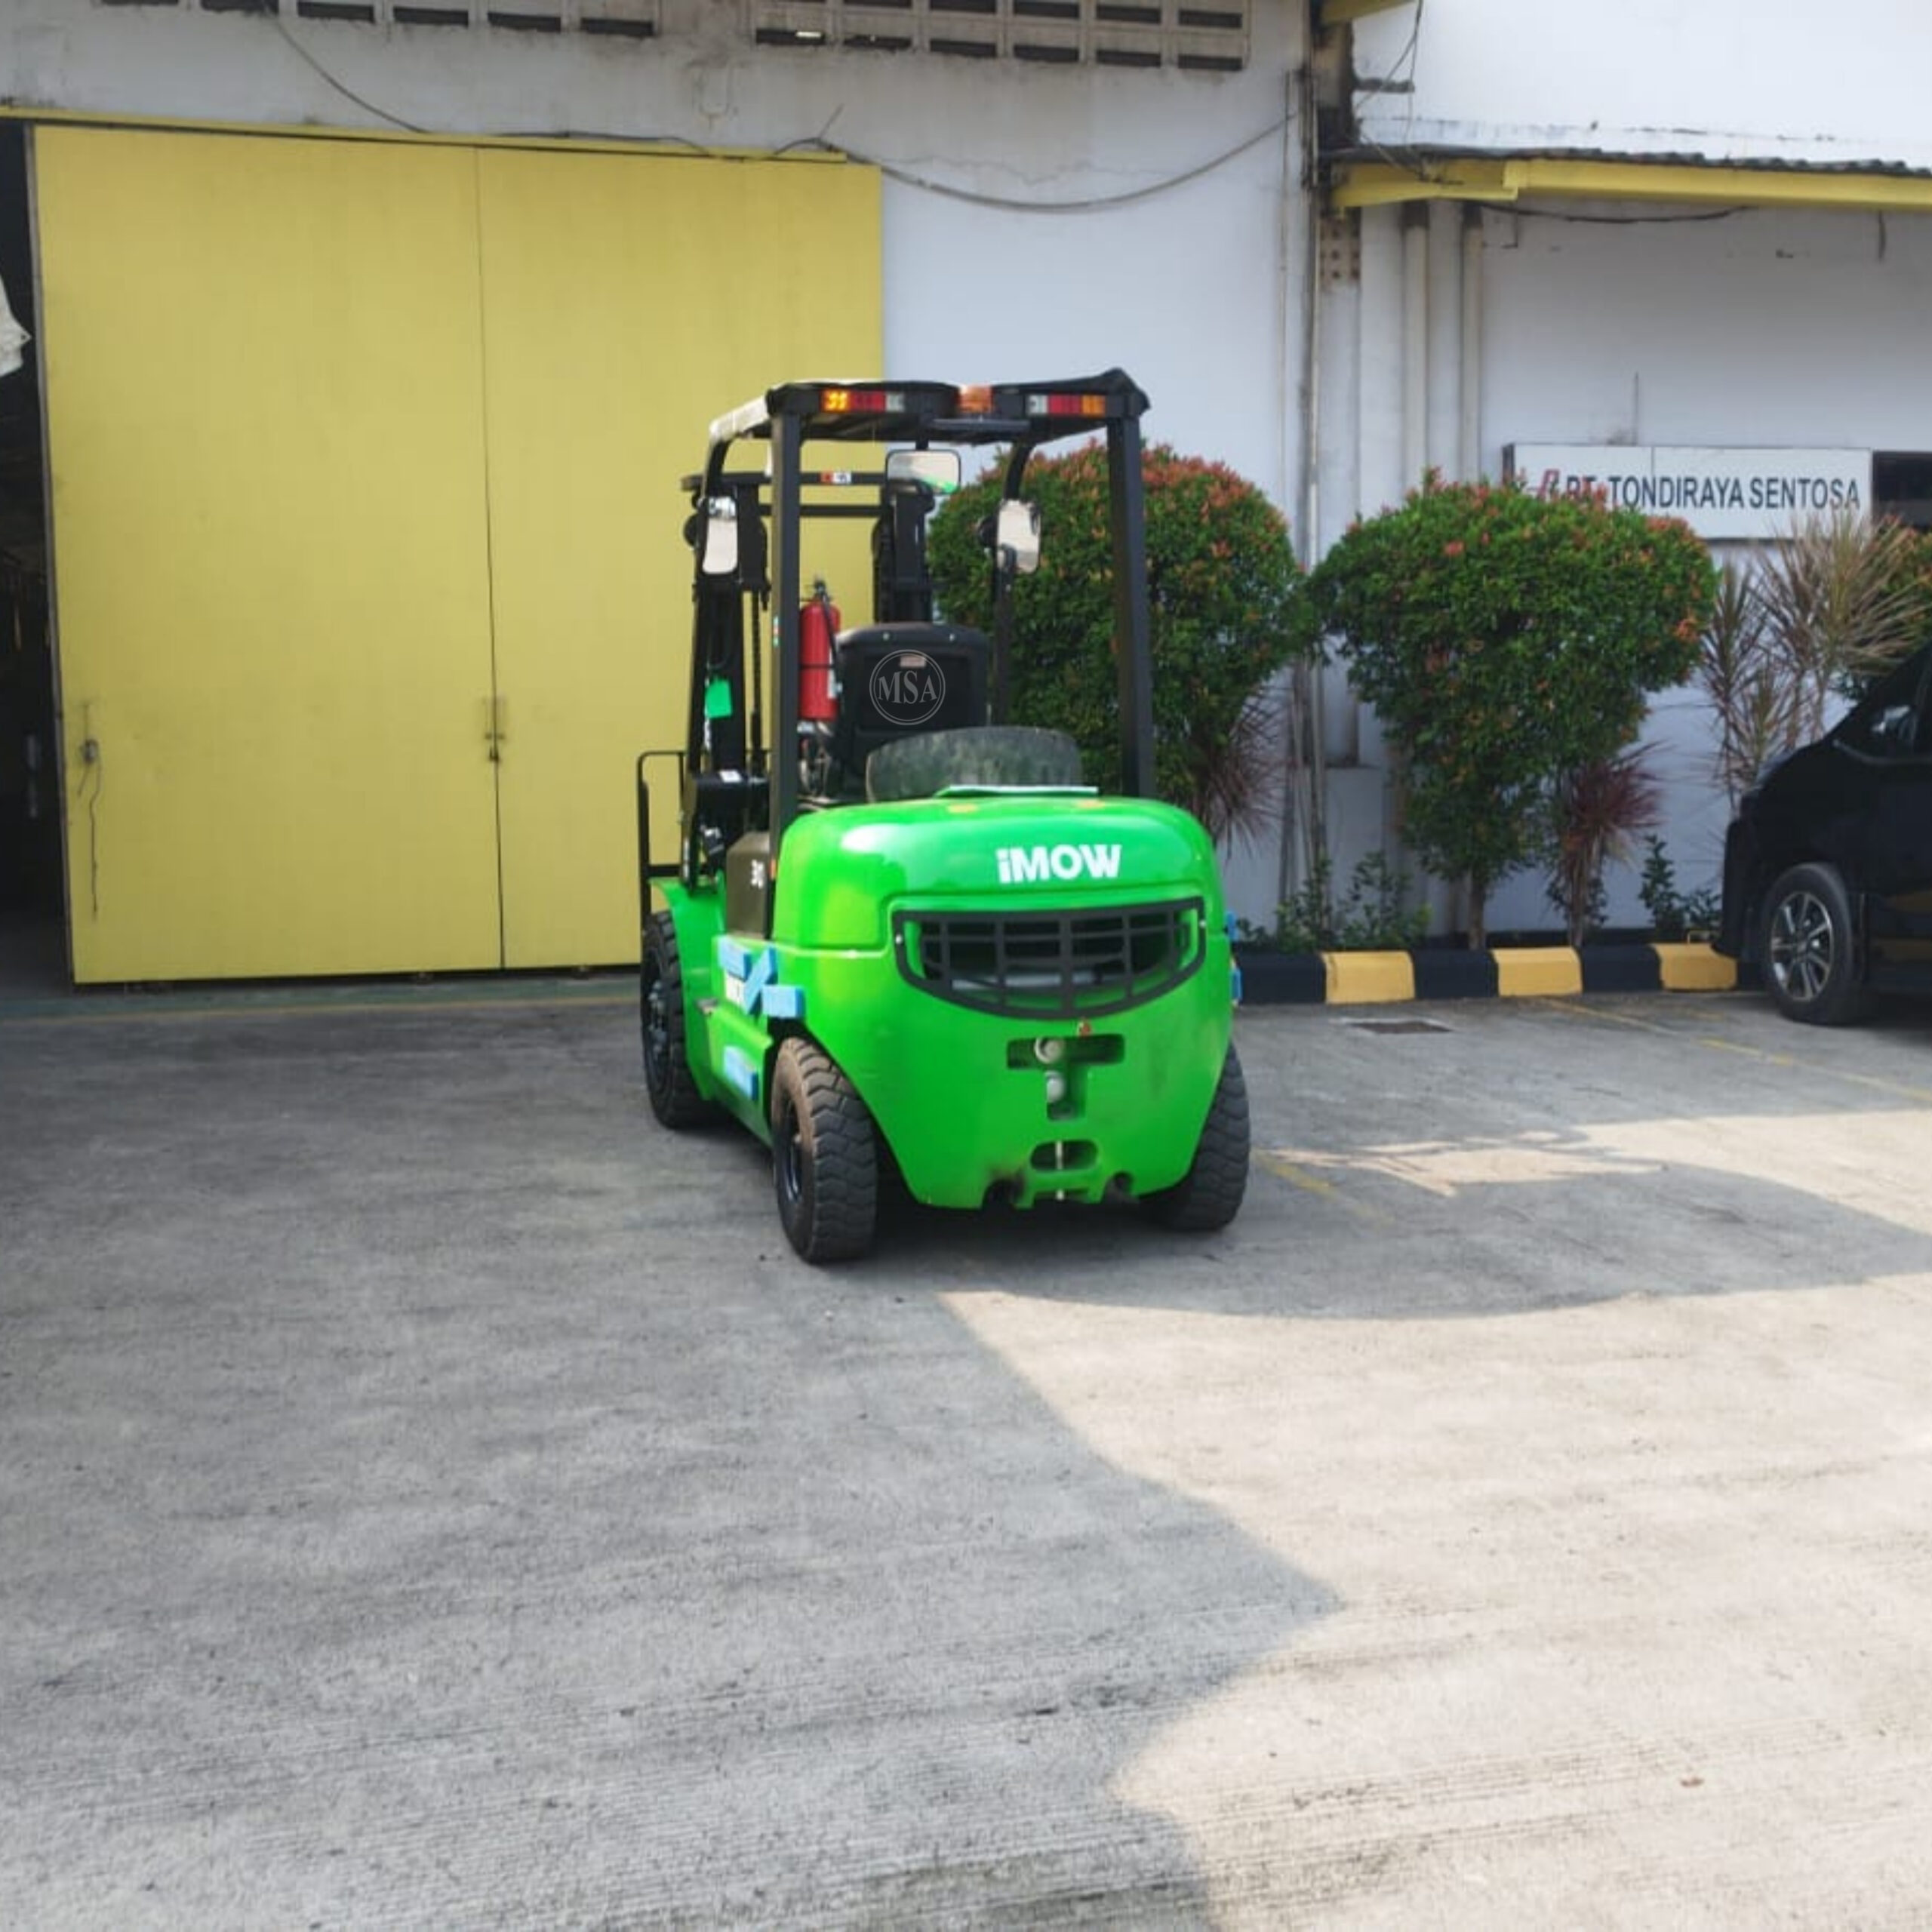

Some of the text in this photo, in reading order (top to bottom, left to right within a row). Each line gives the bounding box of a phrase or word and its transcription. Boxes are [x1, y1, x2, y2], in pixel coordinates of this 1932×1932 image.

[1608, 475, 1744, 509] TONDIRAYA
[1749, 478, 1860, 509] SENTOSA
[995, 844, 1121, 884] iMOW
